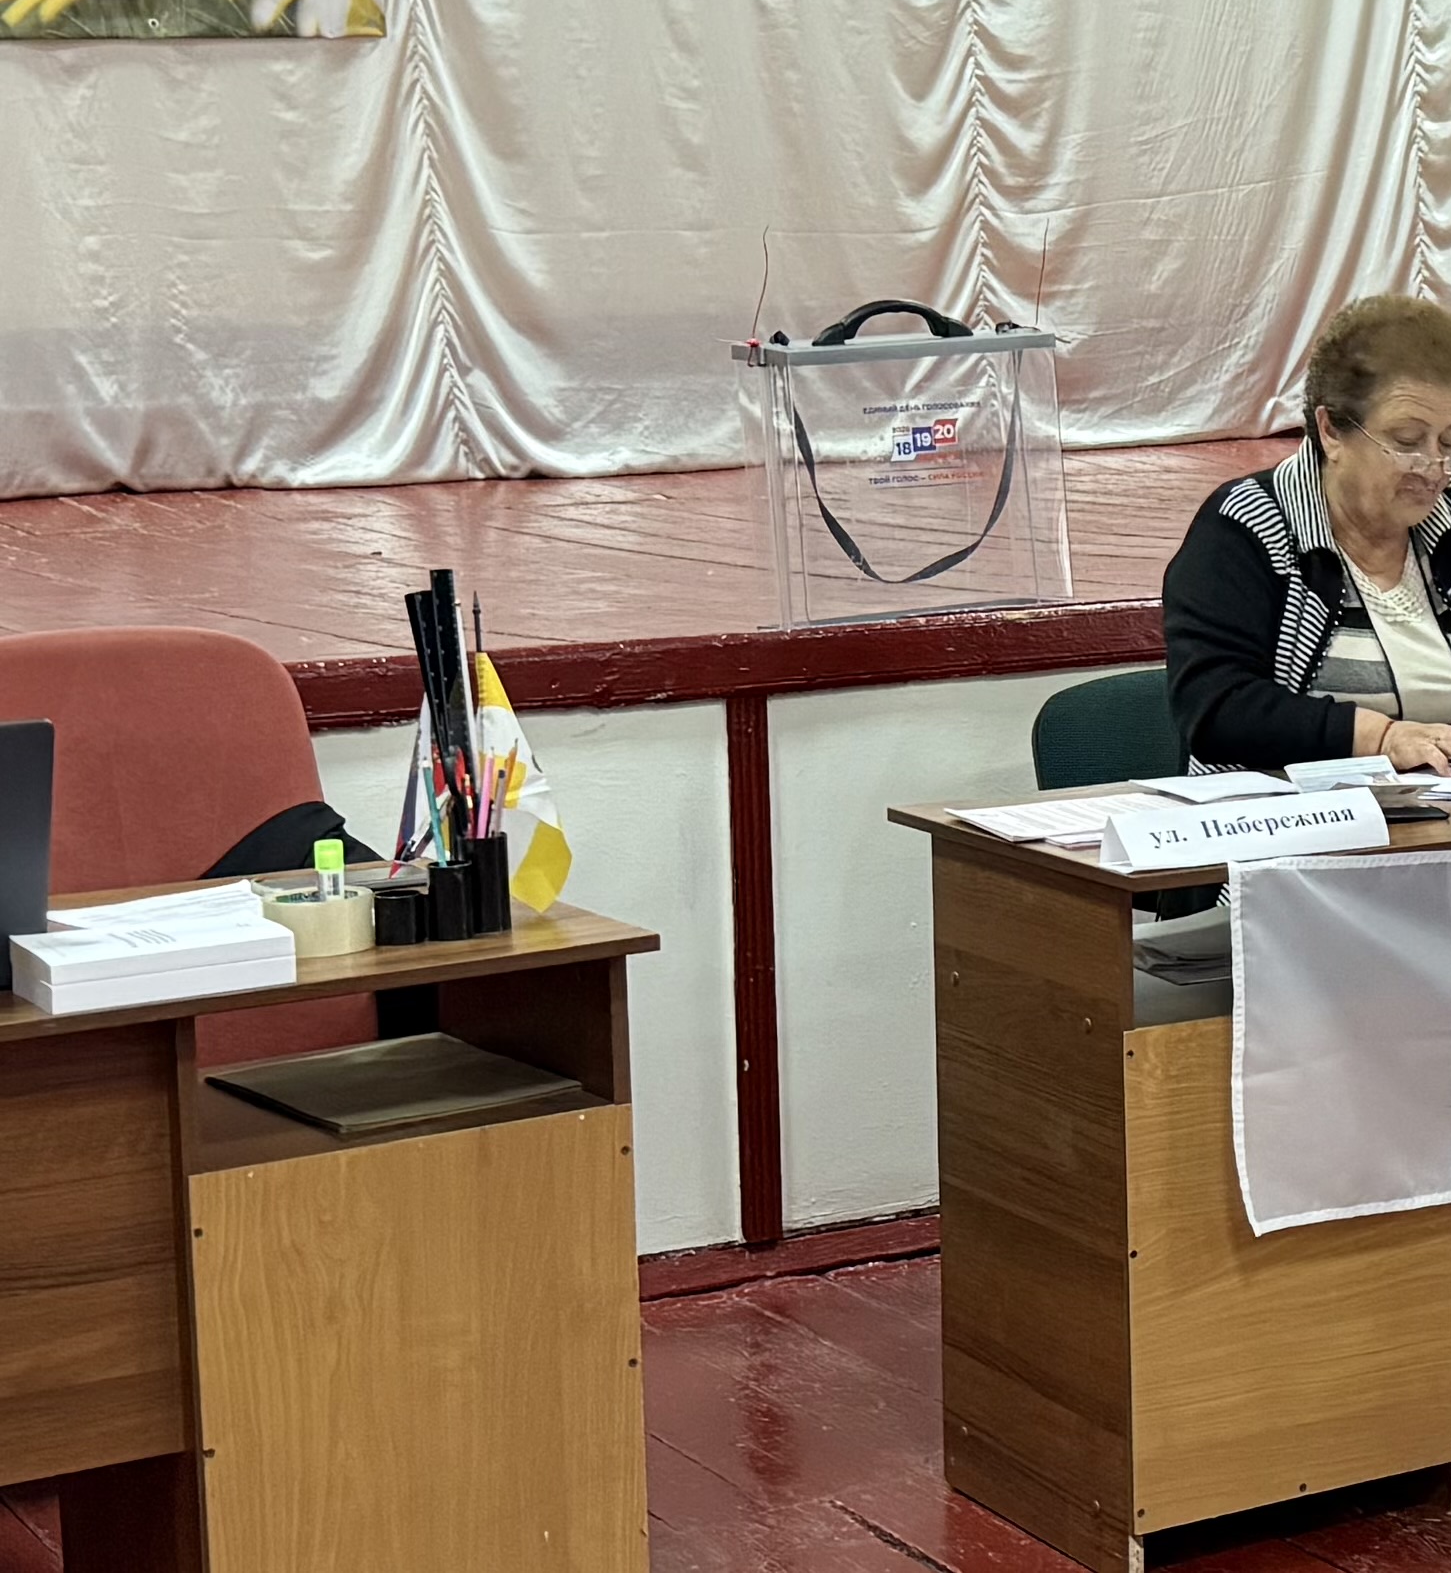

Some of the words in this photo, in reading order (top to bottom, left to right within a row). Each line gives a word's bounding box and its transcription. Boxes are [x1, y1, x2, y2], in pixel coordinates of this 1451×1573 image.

[896, 442, 912, 456] 18
[914, 432, 932, 448] 19
[934, 424, 955, 440] 20
[1148, 829, 1188, 849] ул.
[1200, 807, 1357, 839] Набережная
